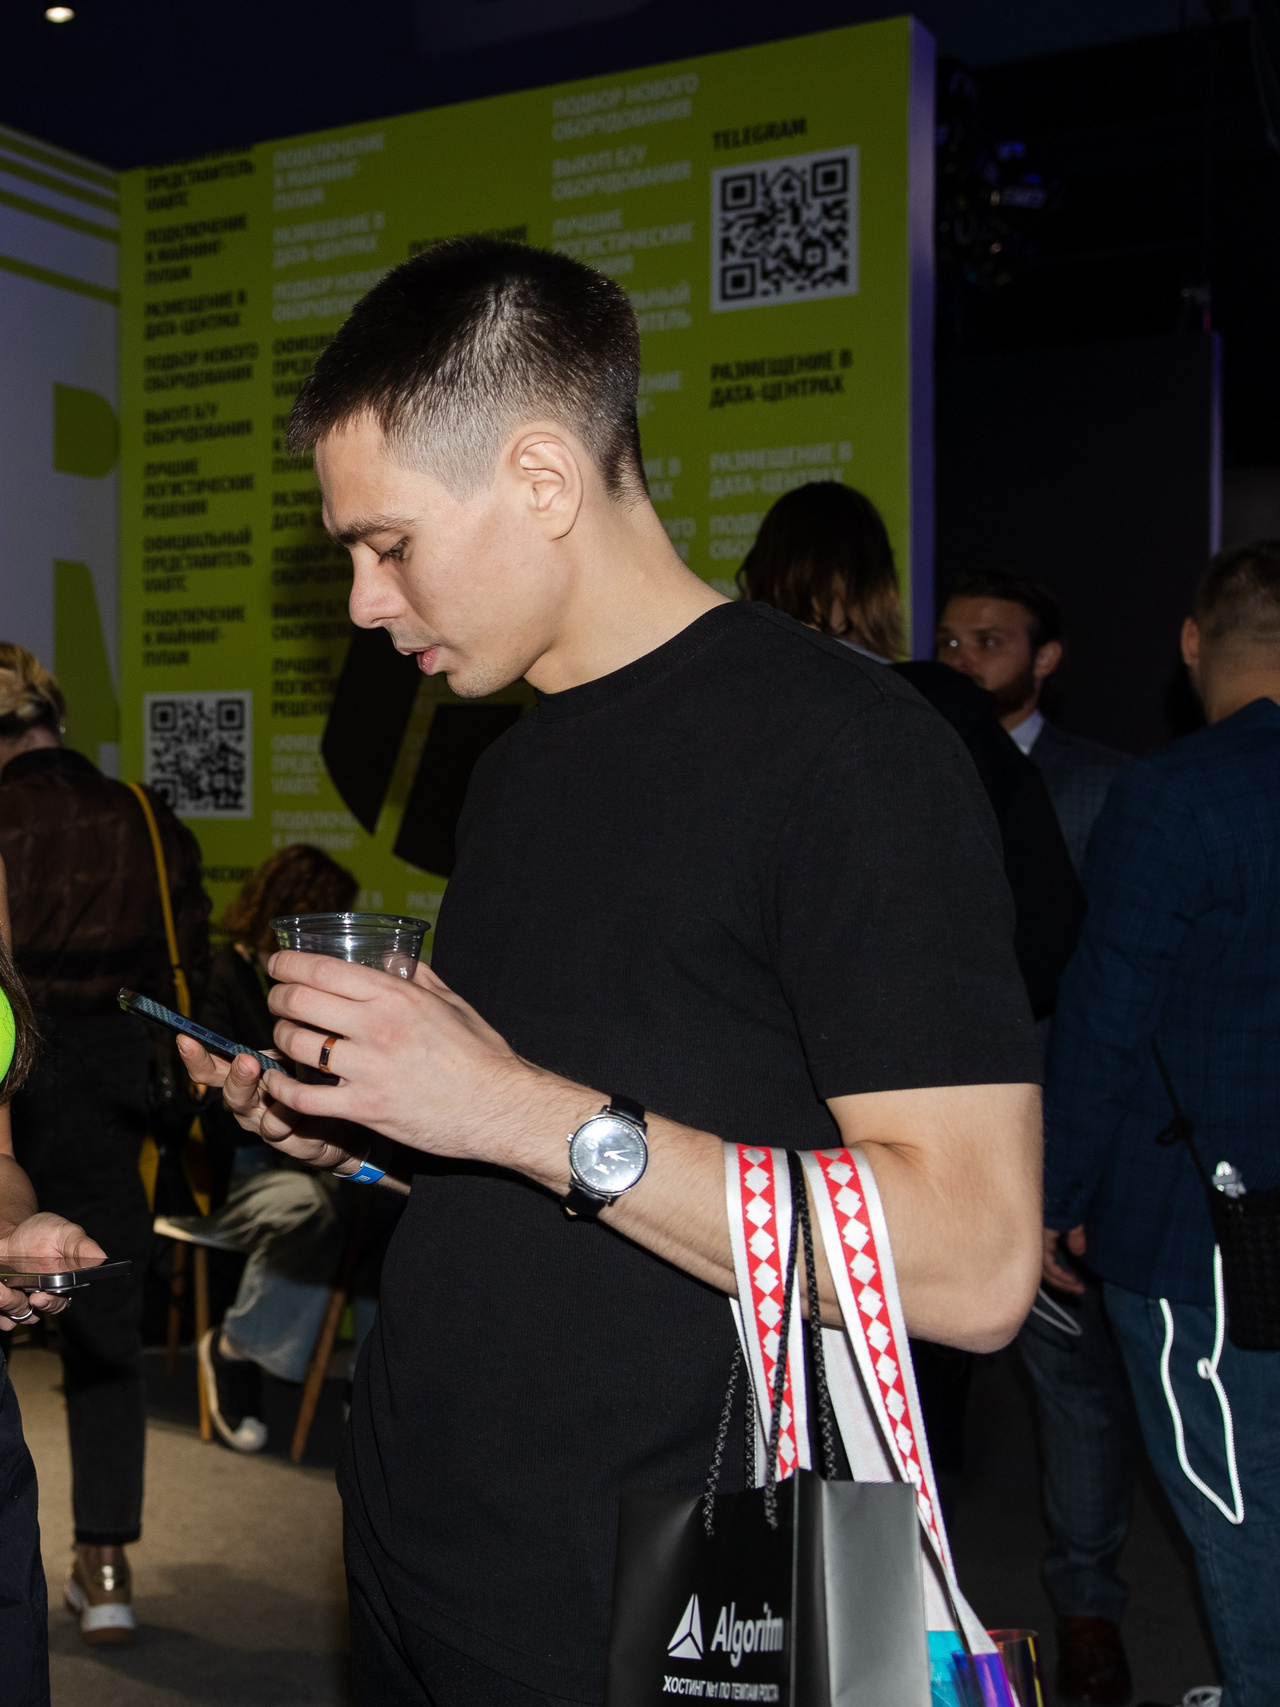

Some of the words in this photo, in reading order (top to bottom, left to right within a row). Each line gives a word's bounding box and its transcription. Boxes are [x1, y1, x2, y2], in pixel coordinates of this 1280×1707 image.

[713, 117, 808, 150] TELEGRAM
[710, 352, 832, 383] РАЗМЕЩЕНИЕ
[839, 349, 853, 369] В
[710, 375, 845, 409] ДАТА-ЦЕНТРАХ
[710, 442, 832, 473] РАЗМЕЩЕНИЕ
[662, 1675, 706, 1697] ХОСТИНГ
